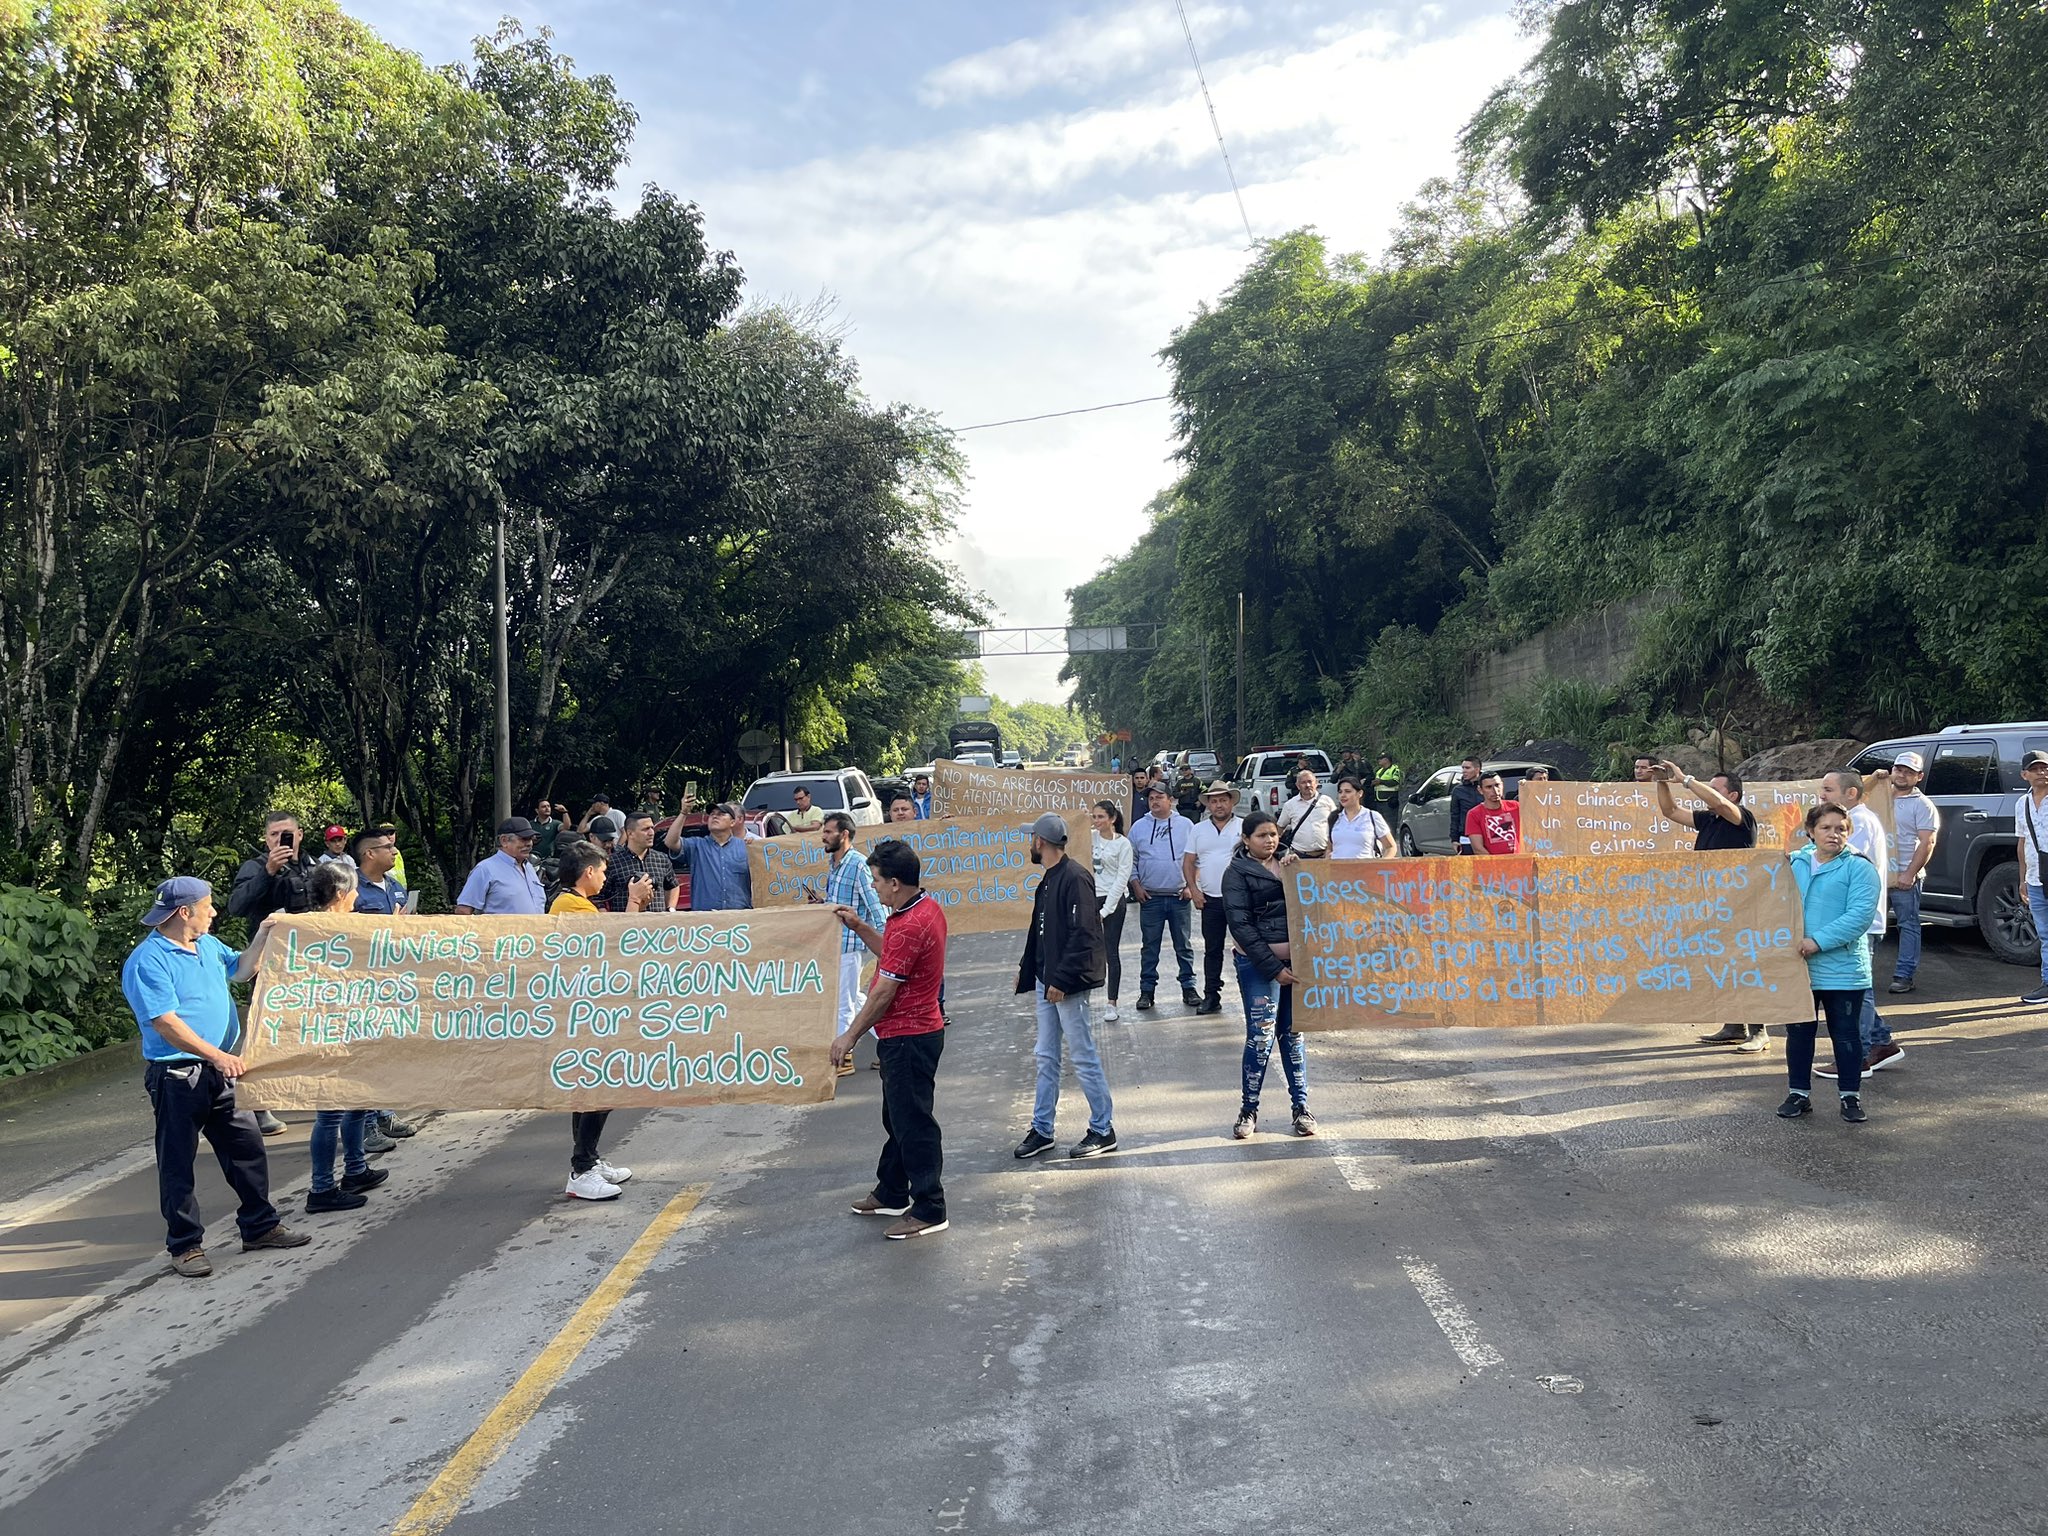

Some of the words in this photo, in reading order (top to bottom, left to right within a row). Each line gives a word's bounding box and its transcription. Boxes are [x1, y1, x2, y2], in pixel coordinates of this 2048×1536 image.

[934, 785, 957, 800] QUE
[962, 788, 1013, 807] ATENTAN
[1017, 793, 1068, 810] CONTRA
[942, 768, 962, 784] NO
[969, 772, 996, 788] MAS
[1002, 776, 1067, 794] ARREGLOS
[1070, 778, 1129, 797] MEDIOCRES
[933, 799, 950, 815] DE
[1541, 817, 1561, 830] un
[1576, 815, 1632, 831] camino
[1648, 816, 1670, 835] de
[1590, 835, 1656, 855] eximos
[968, 876, 1019, 903] debe
[1762, 863, 1783, 891] Y
[1455, 907, 1487, 933] de
[1493, 903, 1518, 931] la
[1618, 896, 1734, 931] exigimos
[287, 928, 353, 973] Las
[368, 928, 480, 969] lluvias
[493, 932, 536, 962] no
[542, 931, 605, 961] son
[619, 923, 751, 955] excusas
[1312, 943, 1421, 980] respeto
[1494, 934, 1628, 967] nuestras
[1734, 926, 1793, 963] que
[263, 970, 419, 1012] estamos
[433, 971, 475, 1000] en
[484, 964, 516, 999] el
[638, 958, 824, 998] RAGONVALIA
[1477, 976, 1499, 1002] a
[1506, 969, 1588, 999] diario
[1596, 973, 1627, 997] en
[1636, 962, 1692, 992] esta
[263, 1015, 284, 1044] Y
[300, 1004, 420, 1044] HERRAN
[432, 1001, 556, 1041] unidos
[550, 1032, 804, 1091] escuchados.
